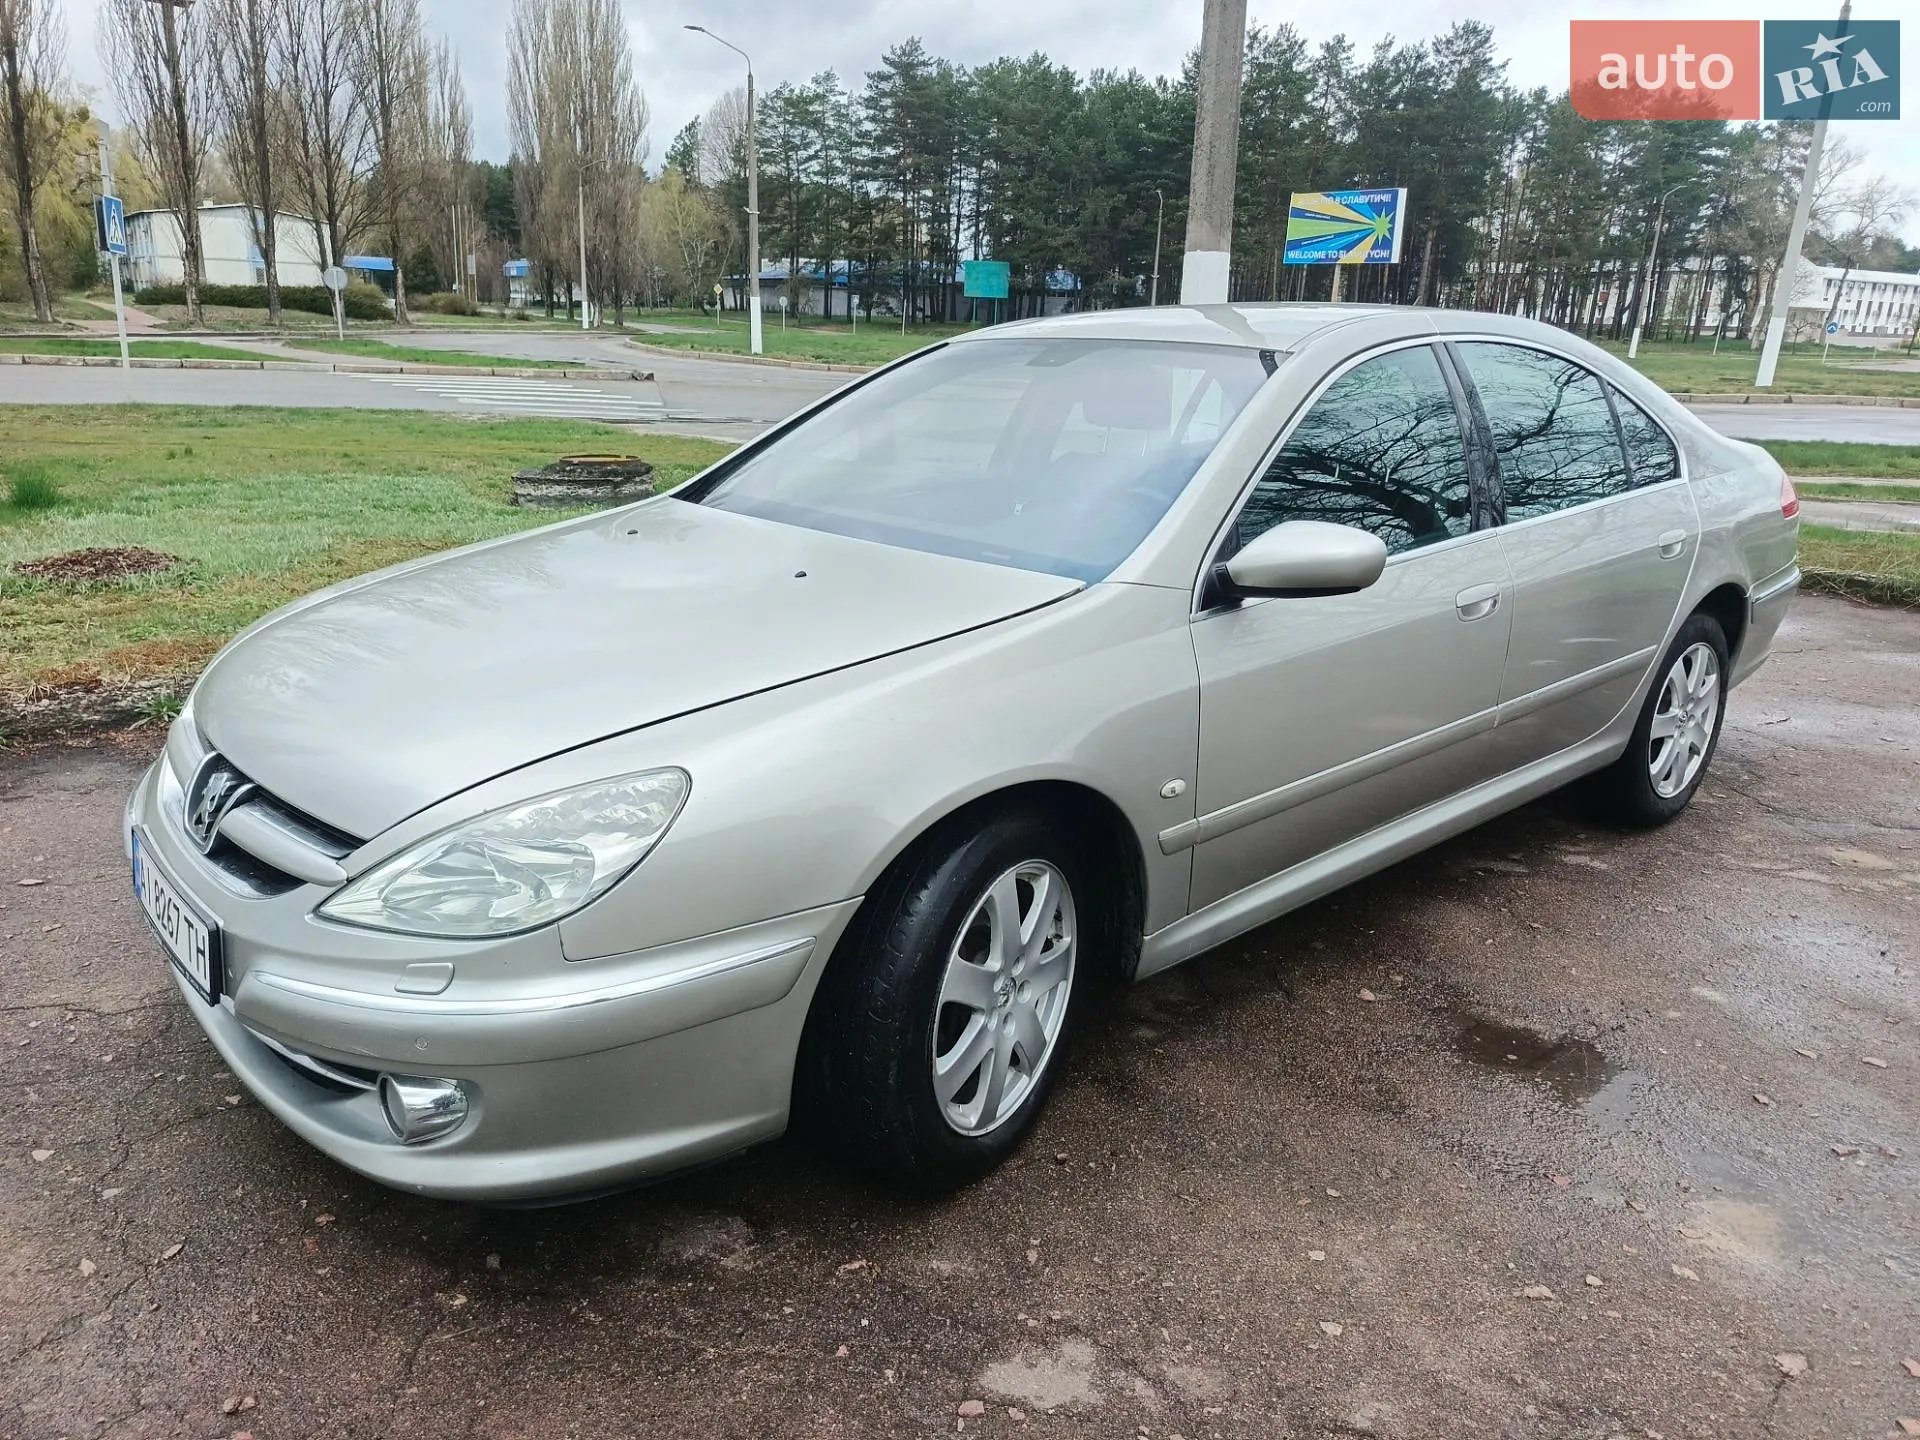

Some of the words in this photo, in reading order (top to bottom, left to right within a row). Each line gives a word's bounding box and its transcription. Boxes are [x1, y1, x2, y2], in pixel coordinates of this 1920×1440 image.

[1287, 250, 1326, 259] WELCOME
[1328, 250, 1338, 259] TO
[154, 879, 181, 945] 8267
[183, 914, 207, 980] TH
